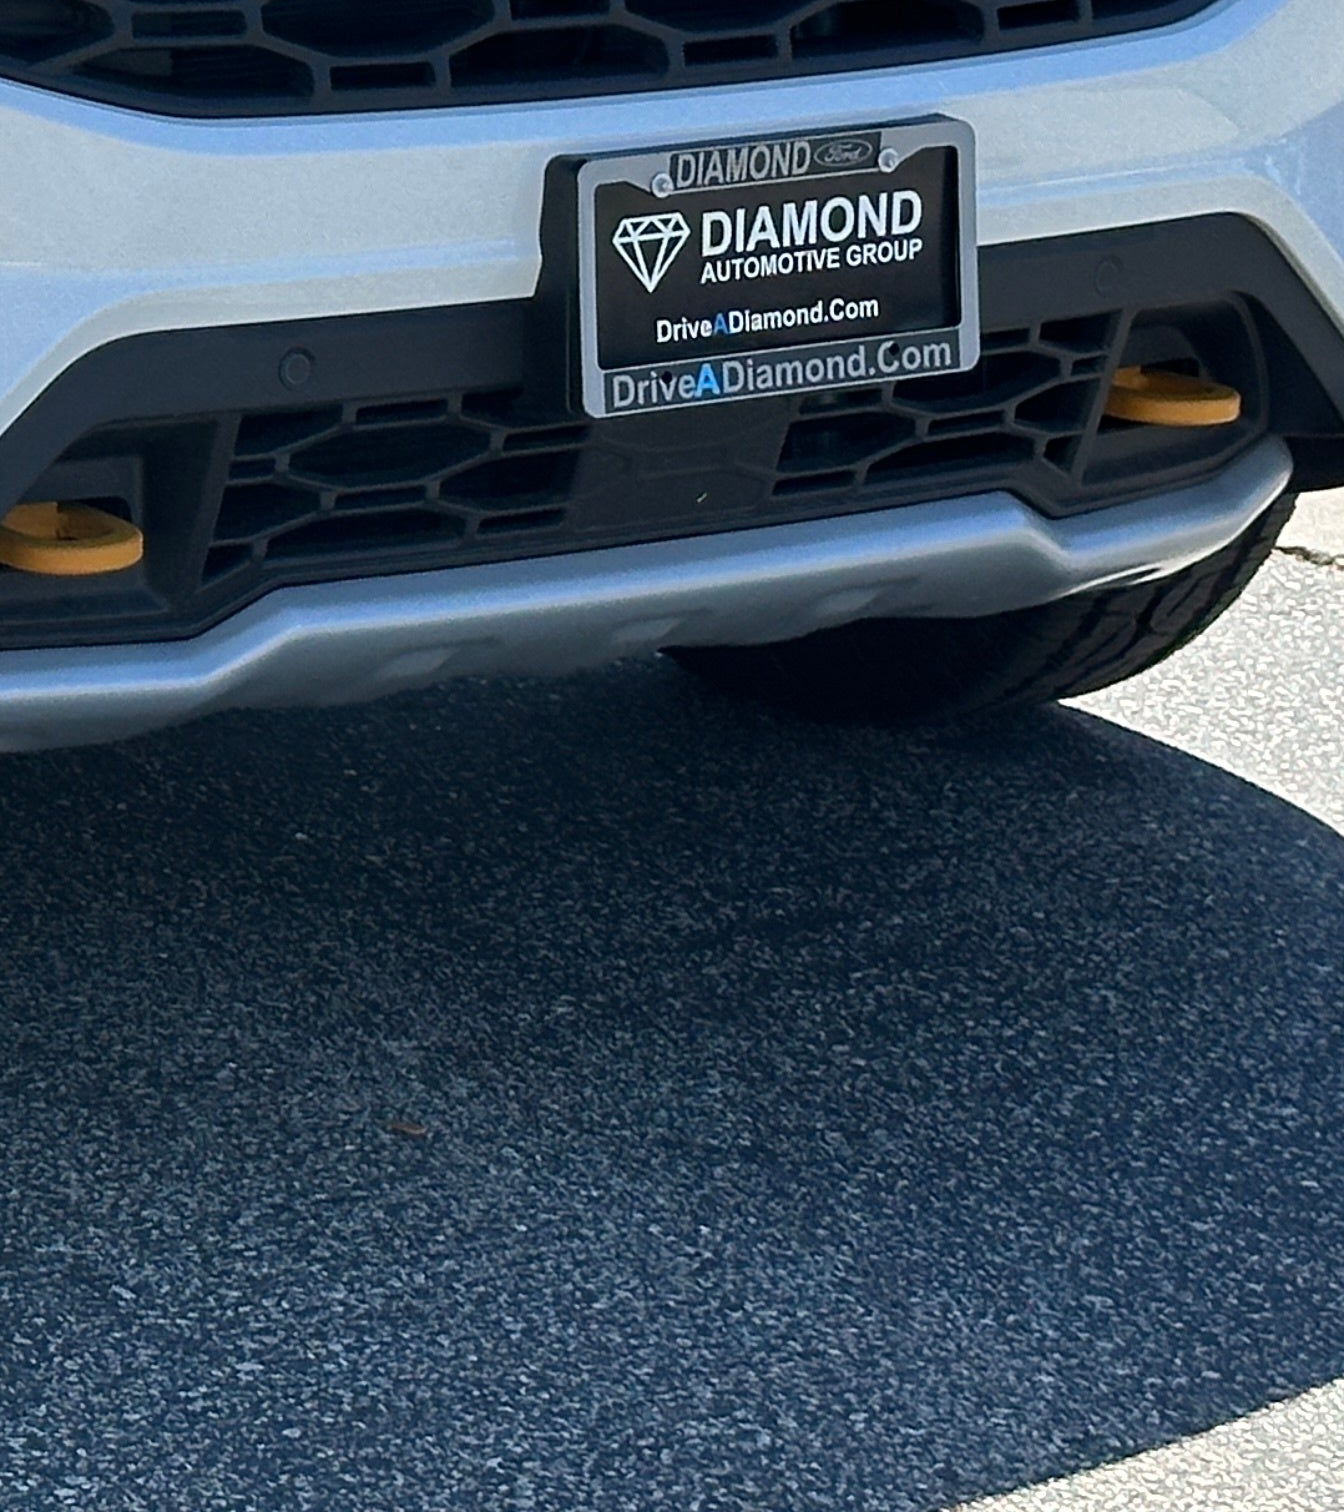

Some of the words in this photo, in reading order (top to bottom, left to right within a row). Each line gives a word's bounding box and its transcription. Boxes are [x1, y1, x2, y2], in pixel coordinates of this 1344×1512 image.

[676, 141, 811, 188] DIAMOND
[701, 190, 923, 257] DIAMOND
[700, 247, 841, 285] AUTOMOTIVE
[846, 238, 923, 267] GROUP
[612, 339, 952, 409] DriveADiamond.Com
